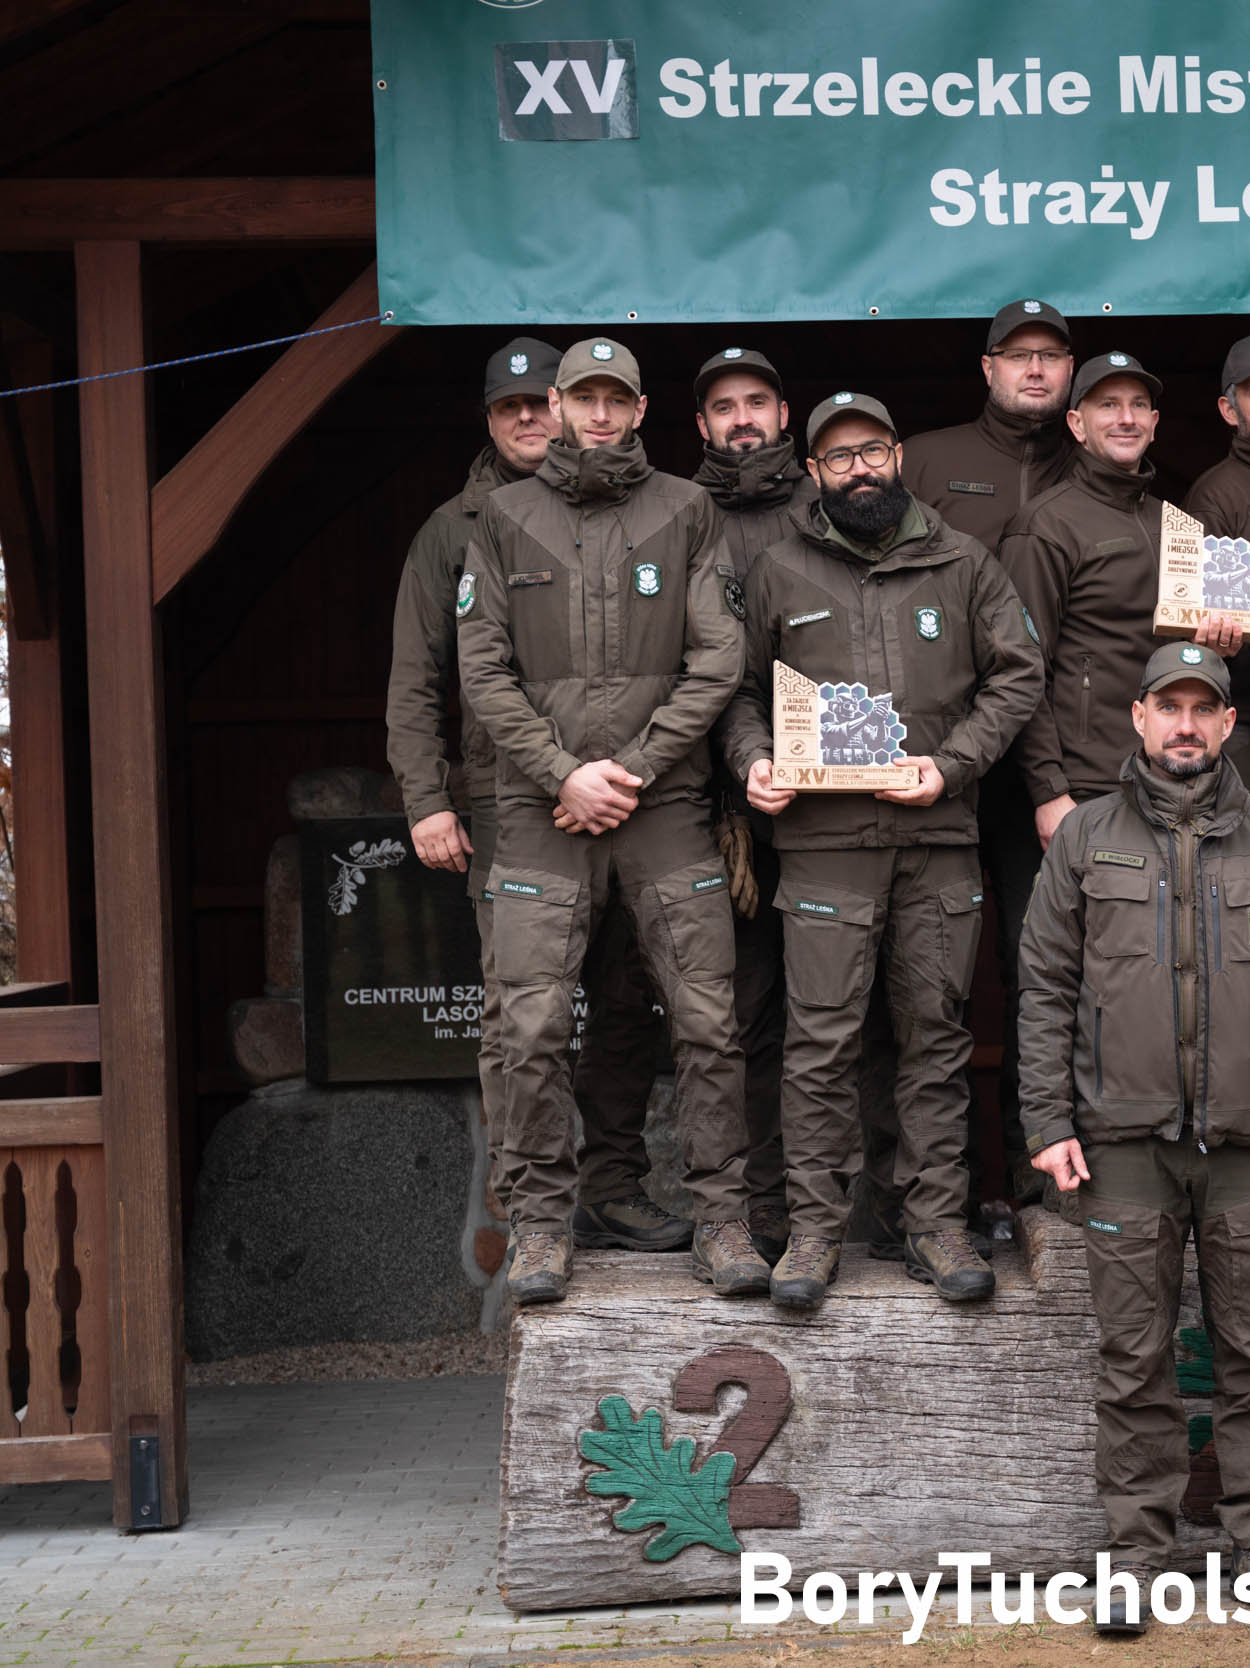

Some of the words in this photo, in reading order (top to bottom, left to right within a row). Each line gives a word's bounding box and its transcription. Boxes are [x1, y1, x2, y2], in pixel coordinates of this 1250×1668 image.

[514, 59, 626, 115] XV
[659, 57, 1091, 118] Strzeleckie
[929, 165, 1171, 240] Straży
[797, 768, 827, 785] XV
[344, 986, 445, 1004] CENTRUM
[435, 1026, 458, 1039] im.
[673, 1344, 800, 1528] 2
